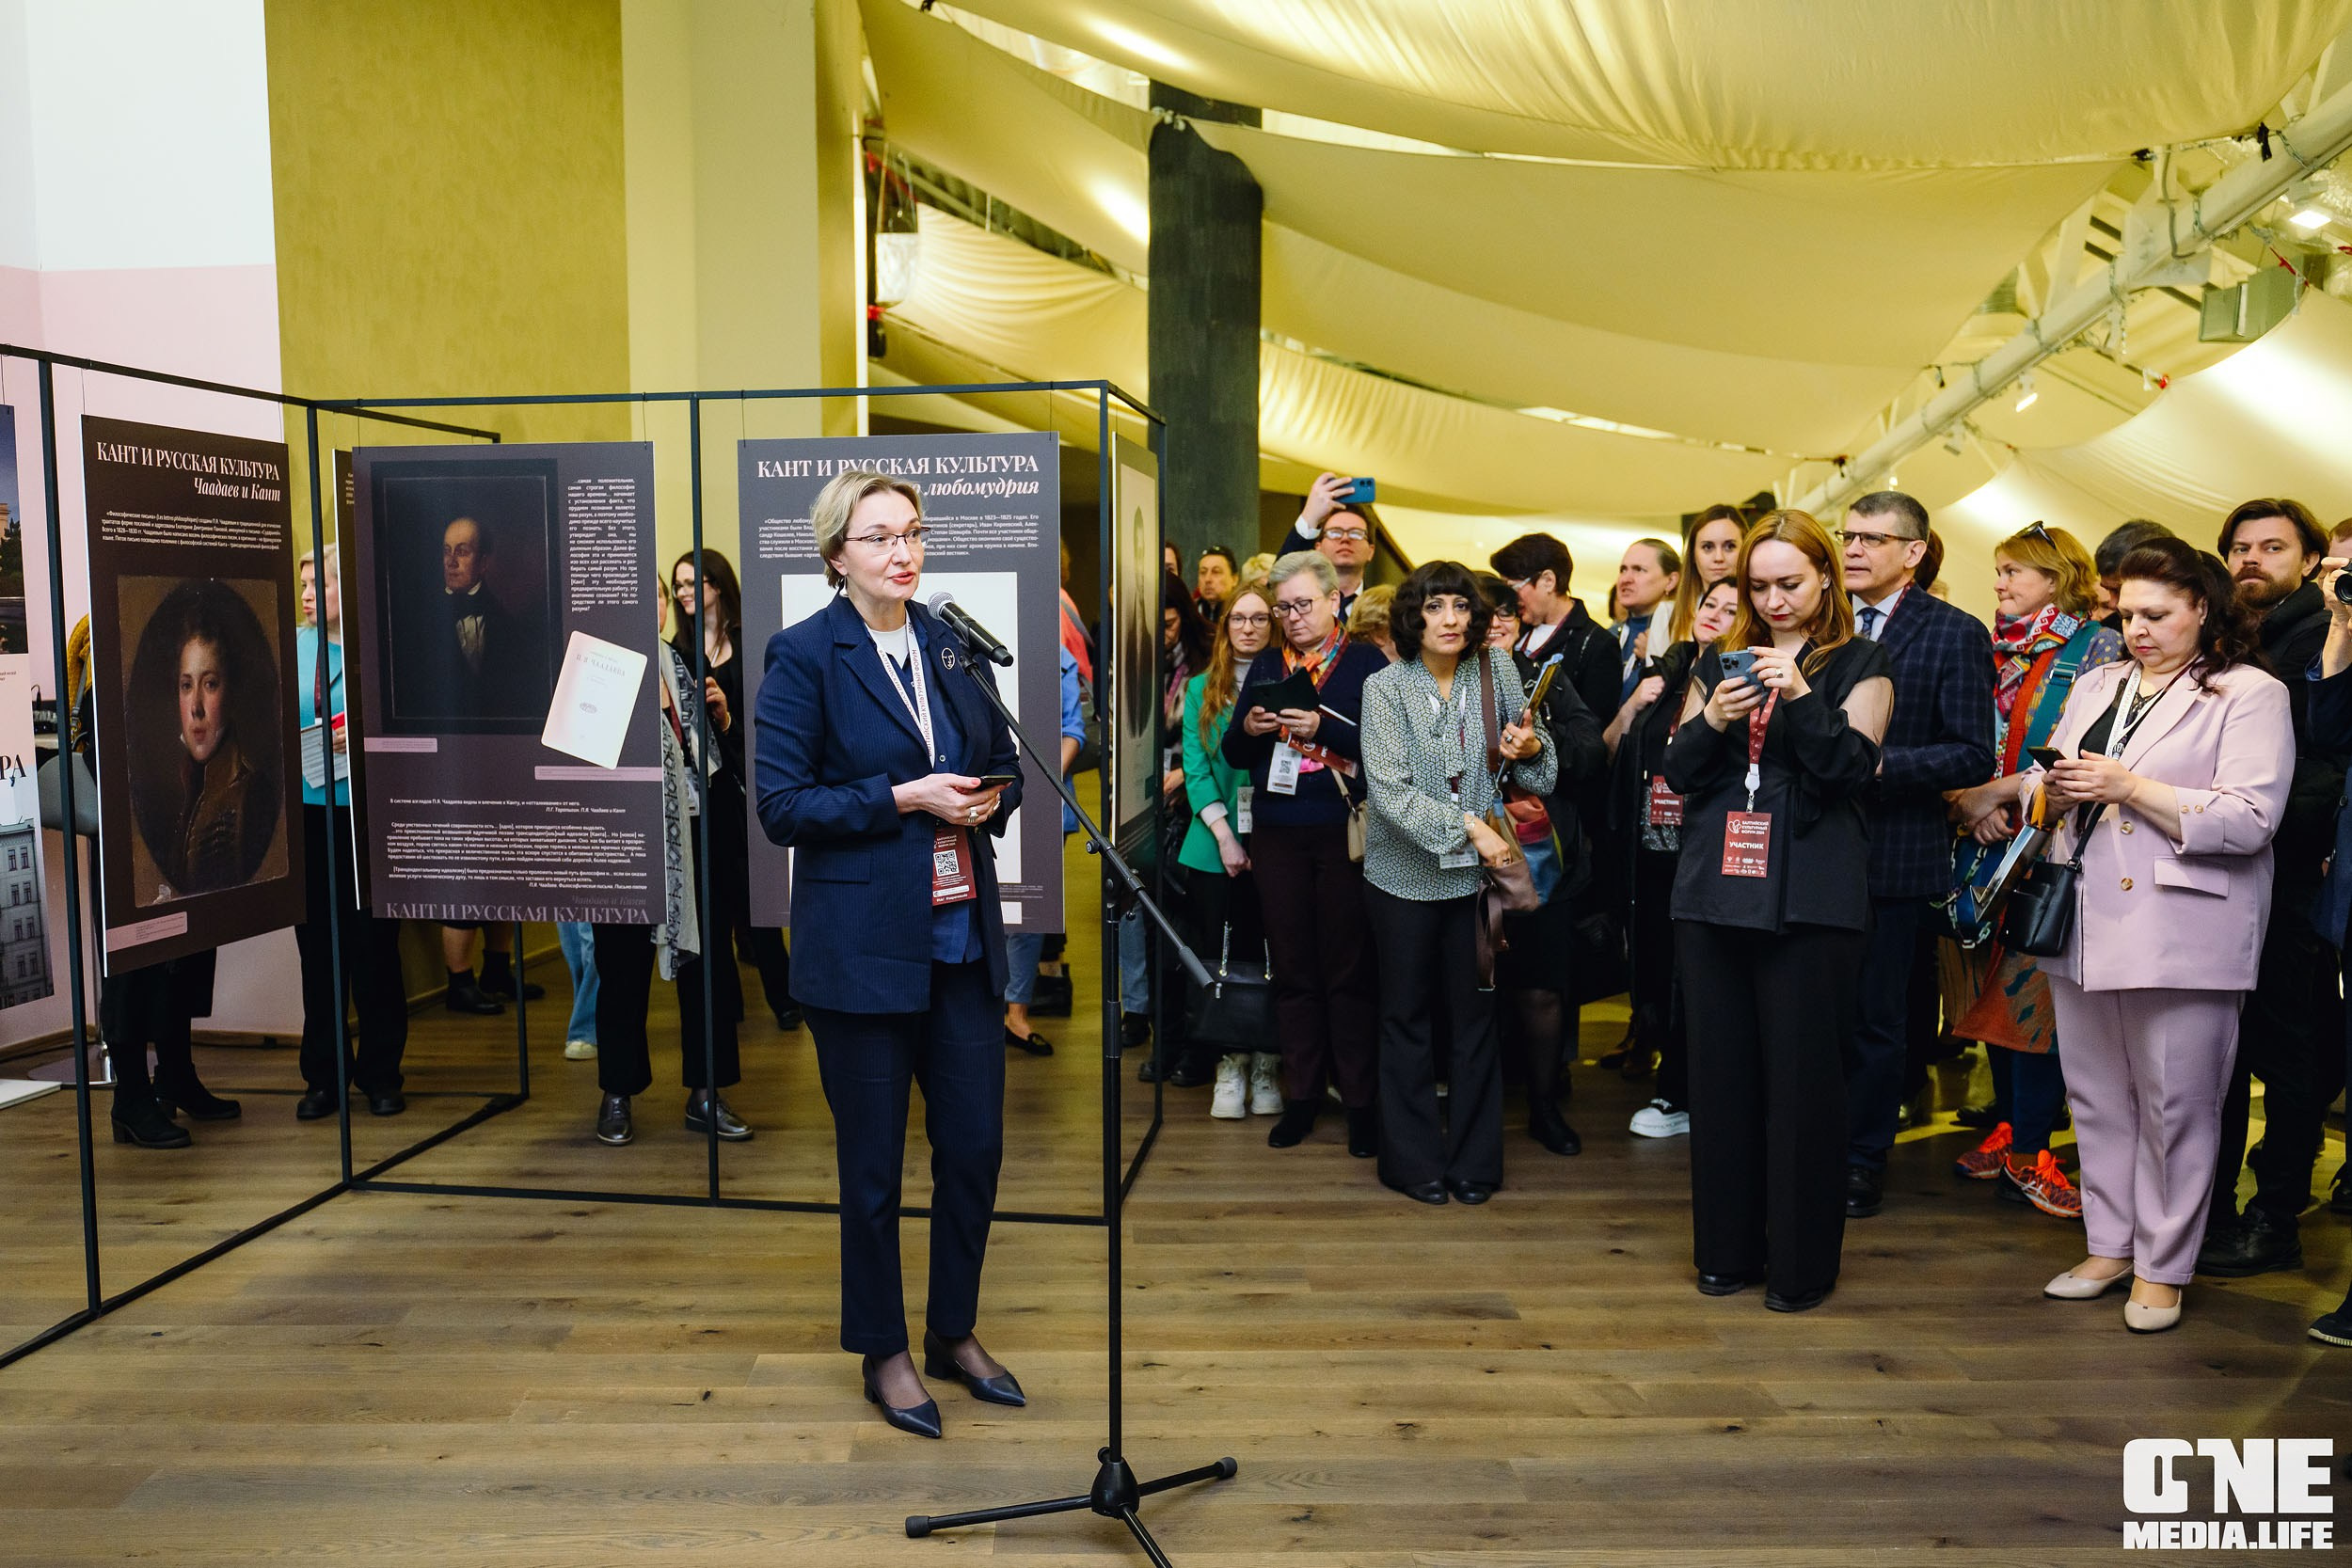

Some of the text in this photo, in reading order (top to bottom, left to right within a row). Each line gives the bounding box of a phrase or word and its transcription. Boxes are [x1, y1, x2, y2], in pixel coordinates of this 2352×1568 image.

[96, 441, 280, 481] КАНТ И РУССКАЯ КУЛЬТУРА
[757, 455, 1039, 477] КАНТ И РУССКАЯ КУЛЬТУРА
[194, 477, 281, 502] Чаадаев и Кант
[924, 477, 1039, 498] любомудрия
[387, 903, 651, 924] КАНТ И РУССКАЯ КУЛЬТУРА
